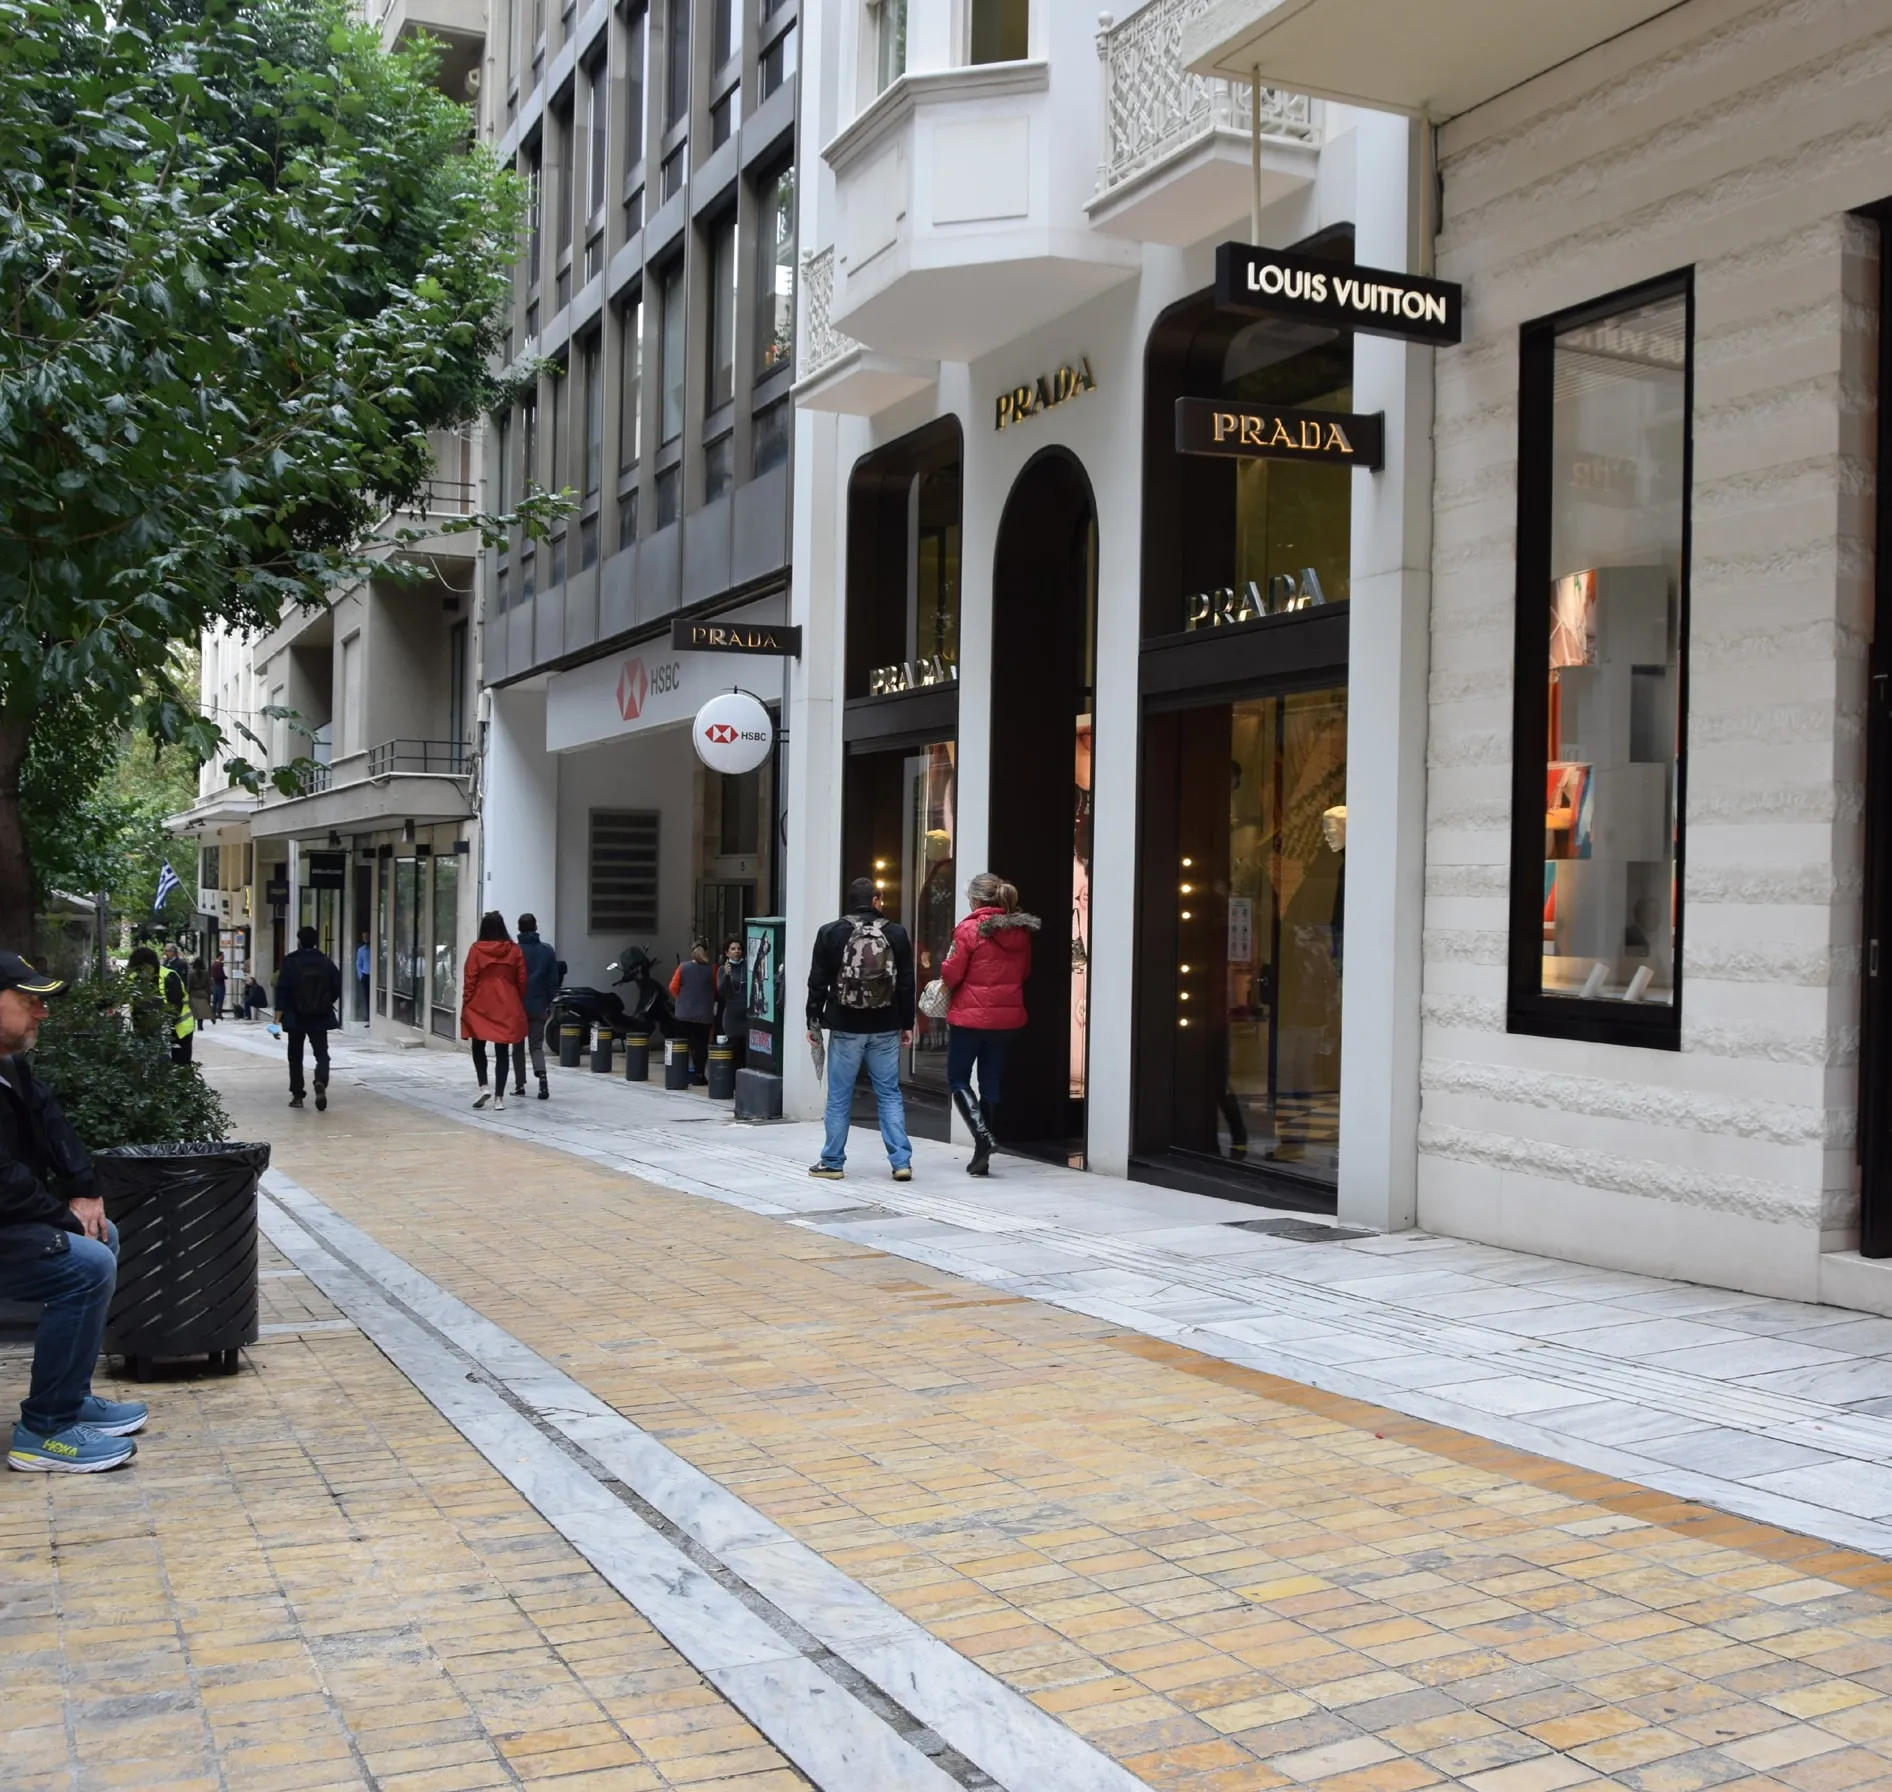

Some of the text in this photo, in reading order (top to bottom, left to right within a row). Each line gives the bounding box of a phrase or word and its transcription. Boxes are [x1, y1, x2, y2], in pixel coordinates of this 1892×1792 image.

[1247, 261, 1447, 325] LOUIS VUITTON
[995, 356, 1096, 431] PRADA
[1212, 412, 1354, 454] PRADA
[1185, 567, 1326, 632] PRADA
[692, 626, 783, 649] PRADA
[650, 661, 680, 696] HSBC
[869, 654, 944, 697] PRADA
[741, 731, 767, 742] HSBC
[42, 1439, 79, 1457] HOKA
